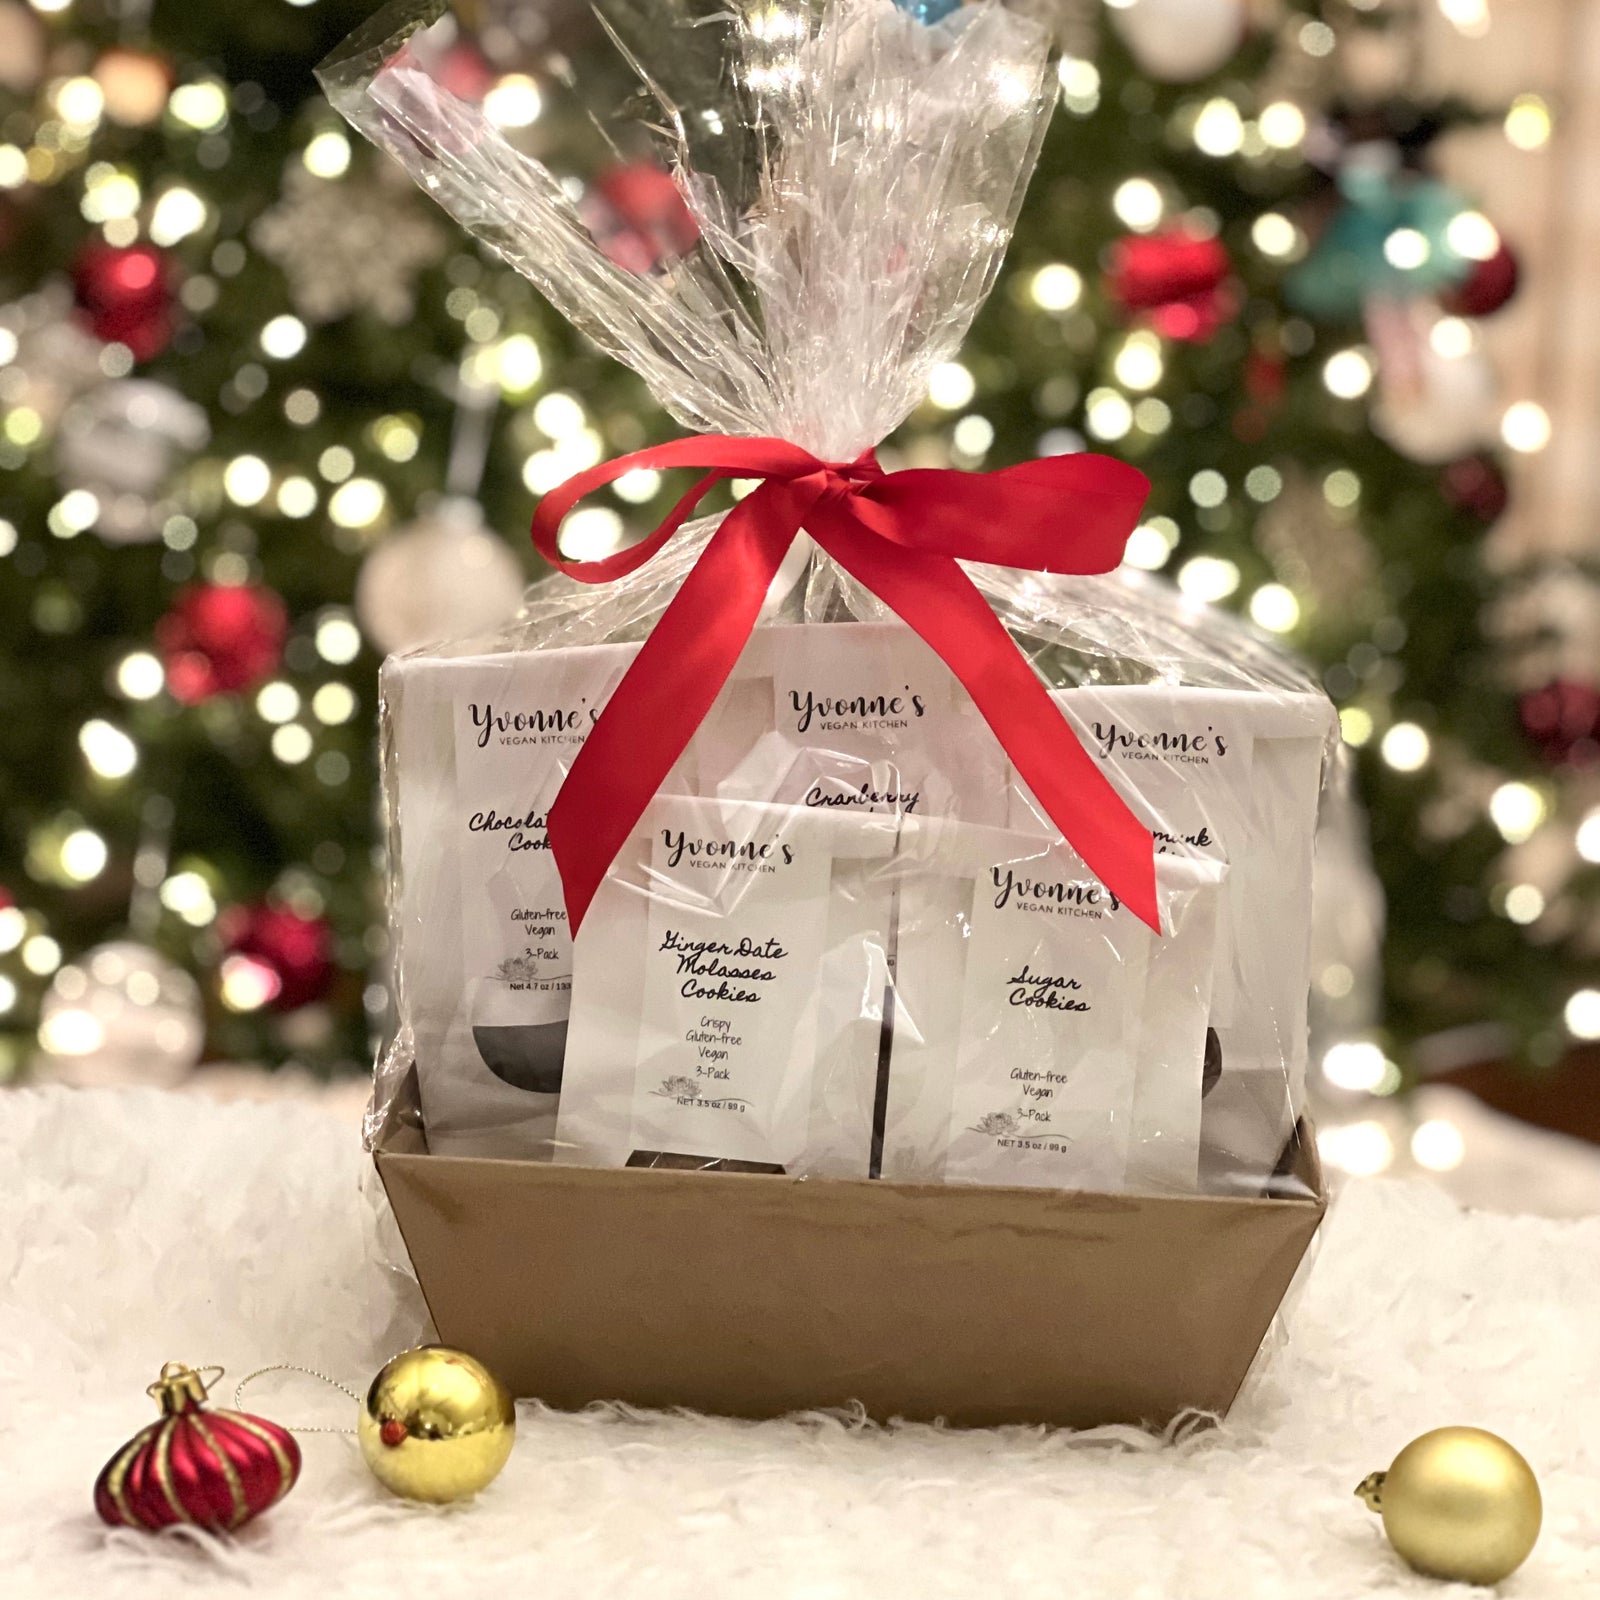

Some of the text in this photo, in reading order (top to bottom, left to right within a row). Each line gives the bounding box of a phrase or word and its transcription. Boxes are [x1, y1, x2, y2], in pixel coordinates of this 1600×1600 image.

[788, 684, 926, 732] Yvonne's
[820, 720, 908, 730] VEGAN KITCHEN
[500, 735, 536, 745] VEGAN
[1091, 722, 1229, 759] Yvonne's
[1122, 751, 1209, 764] VEGAN KITCHEN
[661, 829, 795, 868] Yvonne's
[690, 860, 776, 873] VEGAN KITCHEN
[510, 908, 567, 921] Gluten-free
[1017, 902, 1102, 919] VEGAN KITCHEN
[525, 924, 555, 939] Vegan
[525, 948, 559, 960] 3-Pack
[659, 930, 789, 963] Ginger Date
[676, 953, 776, 981] Molasses
[510, 983, 524, 991] Net
[1006, 965, 1082, 997] Sugar
[681, 978, 761, 1002] Cookies
[1009, 987, 1091, 1012] Cookies
[700, 1015, 731, 1033] Crispy
[686, 1029, 742, 1046] Gluten-free
[698, 1046, 729, 1062] Vegan
[696, 1065, 730, 1080] 3-Pack
[1010, 1067, 1068, 1084] Gluten-free
[1022, 1083, 1053, 1101] Vegan
[677, 1096, 694, 1106] NET
[697, 1099, 710, 1107] 3.5
[1017, 1107, 1051, 1122] 3-Pack
[997, 1139, 1015, 1148] NET
[1017, 1141, 1030, 1149] 3.5
[1061, 1145, 1067, 1153] g
